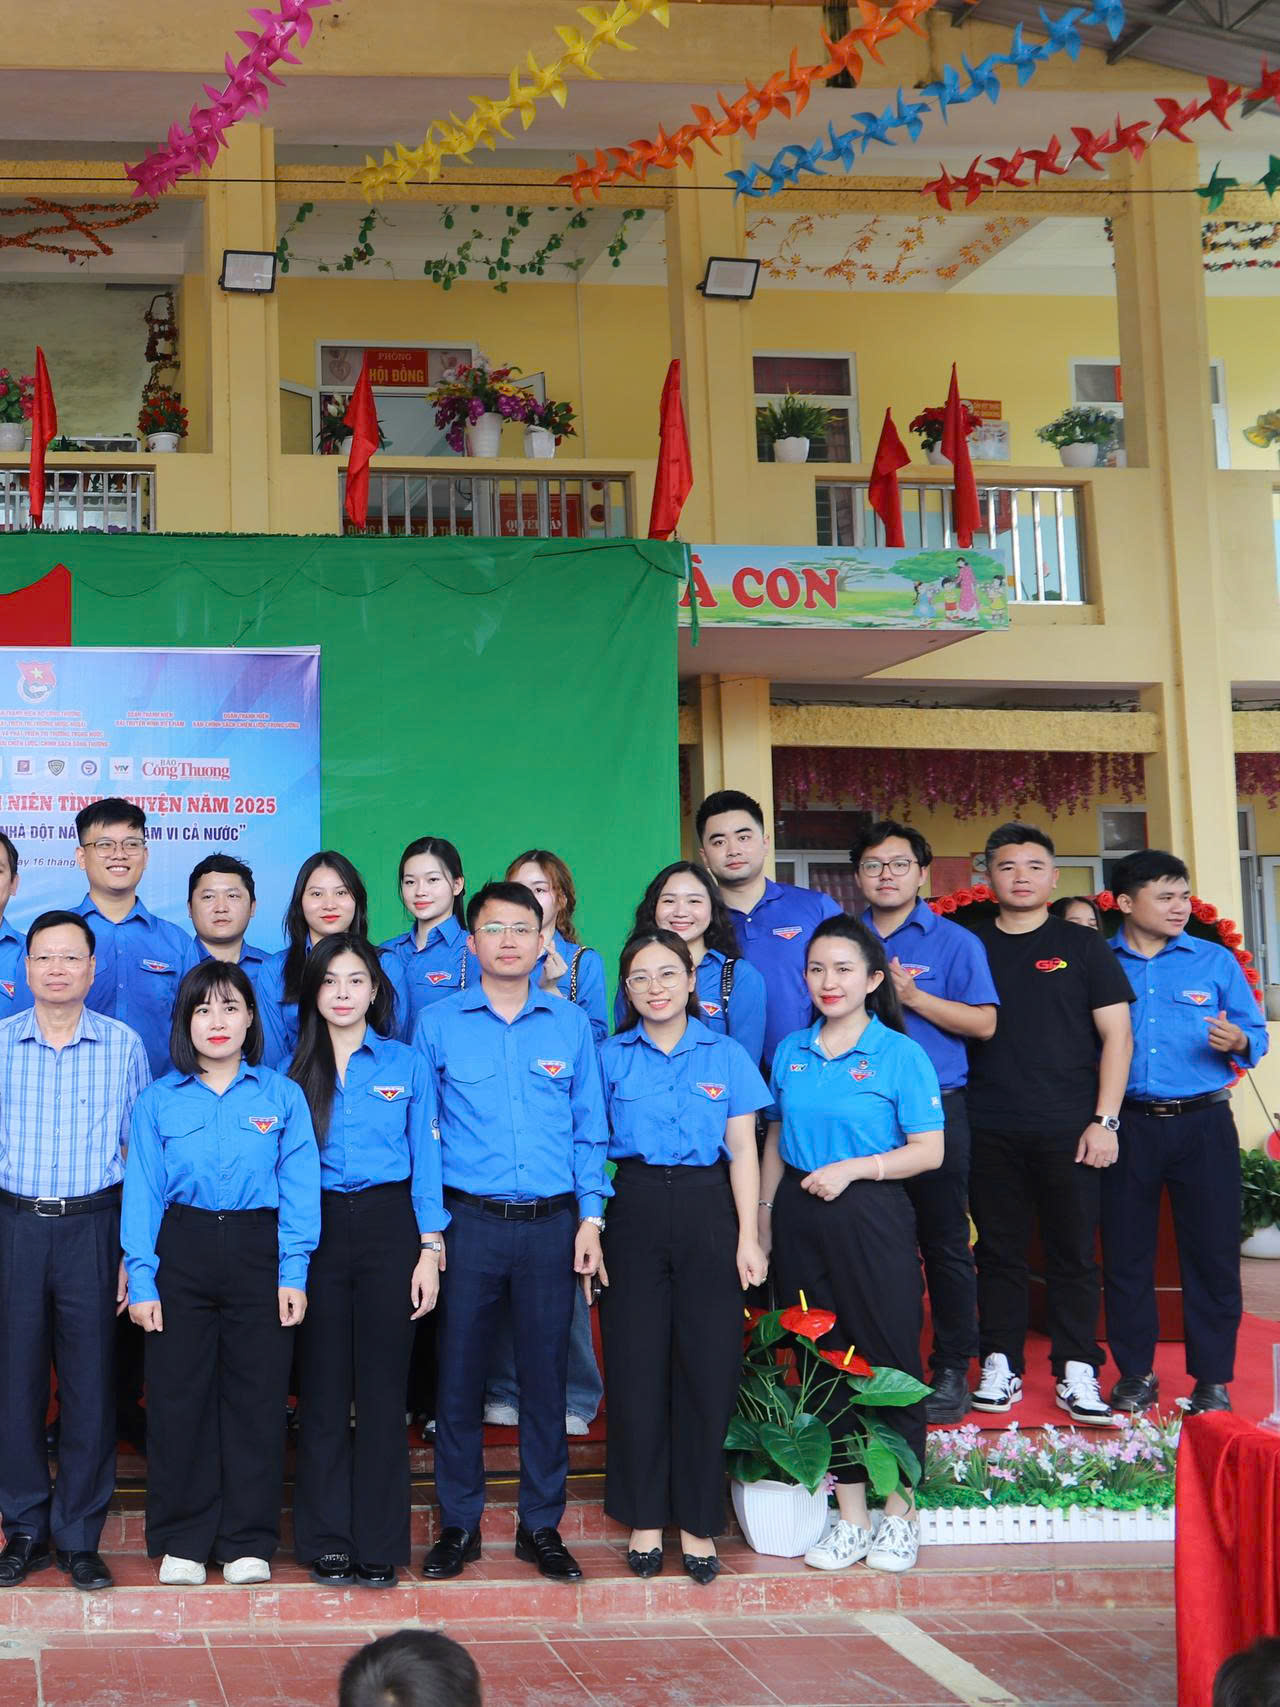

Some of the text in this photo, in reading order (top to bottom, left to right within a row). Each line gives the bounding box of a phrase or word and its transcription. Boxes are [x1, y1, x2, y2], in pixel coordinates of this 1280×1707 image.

[378, 352, 412, 360] PHÒNG
[369, 363, 425, 384] HỘI ĐỒNG
[732, 567, 839, 609] CON
[7, 792, 53, 811] NIÊN
[187, 794, 229, 813] NĂM
[234, 797, 276, 813] 2025
[30, 823, 54, 842] ĐỘT
[166, 827, 178, 840] VI
[182, 822, 200, 841] CẢ
[33, 857, 44, 866] 16
